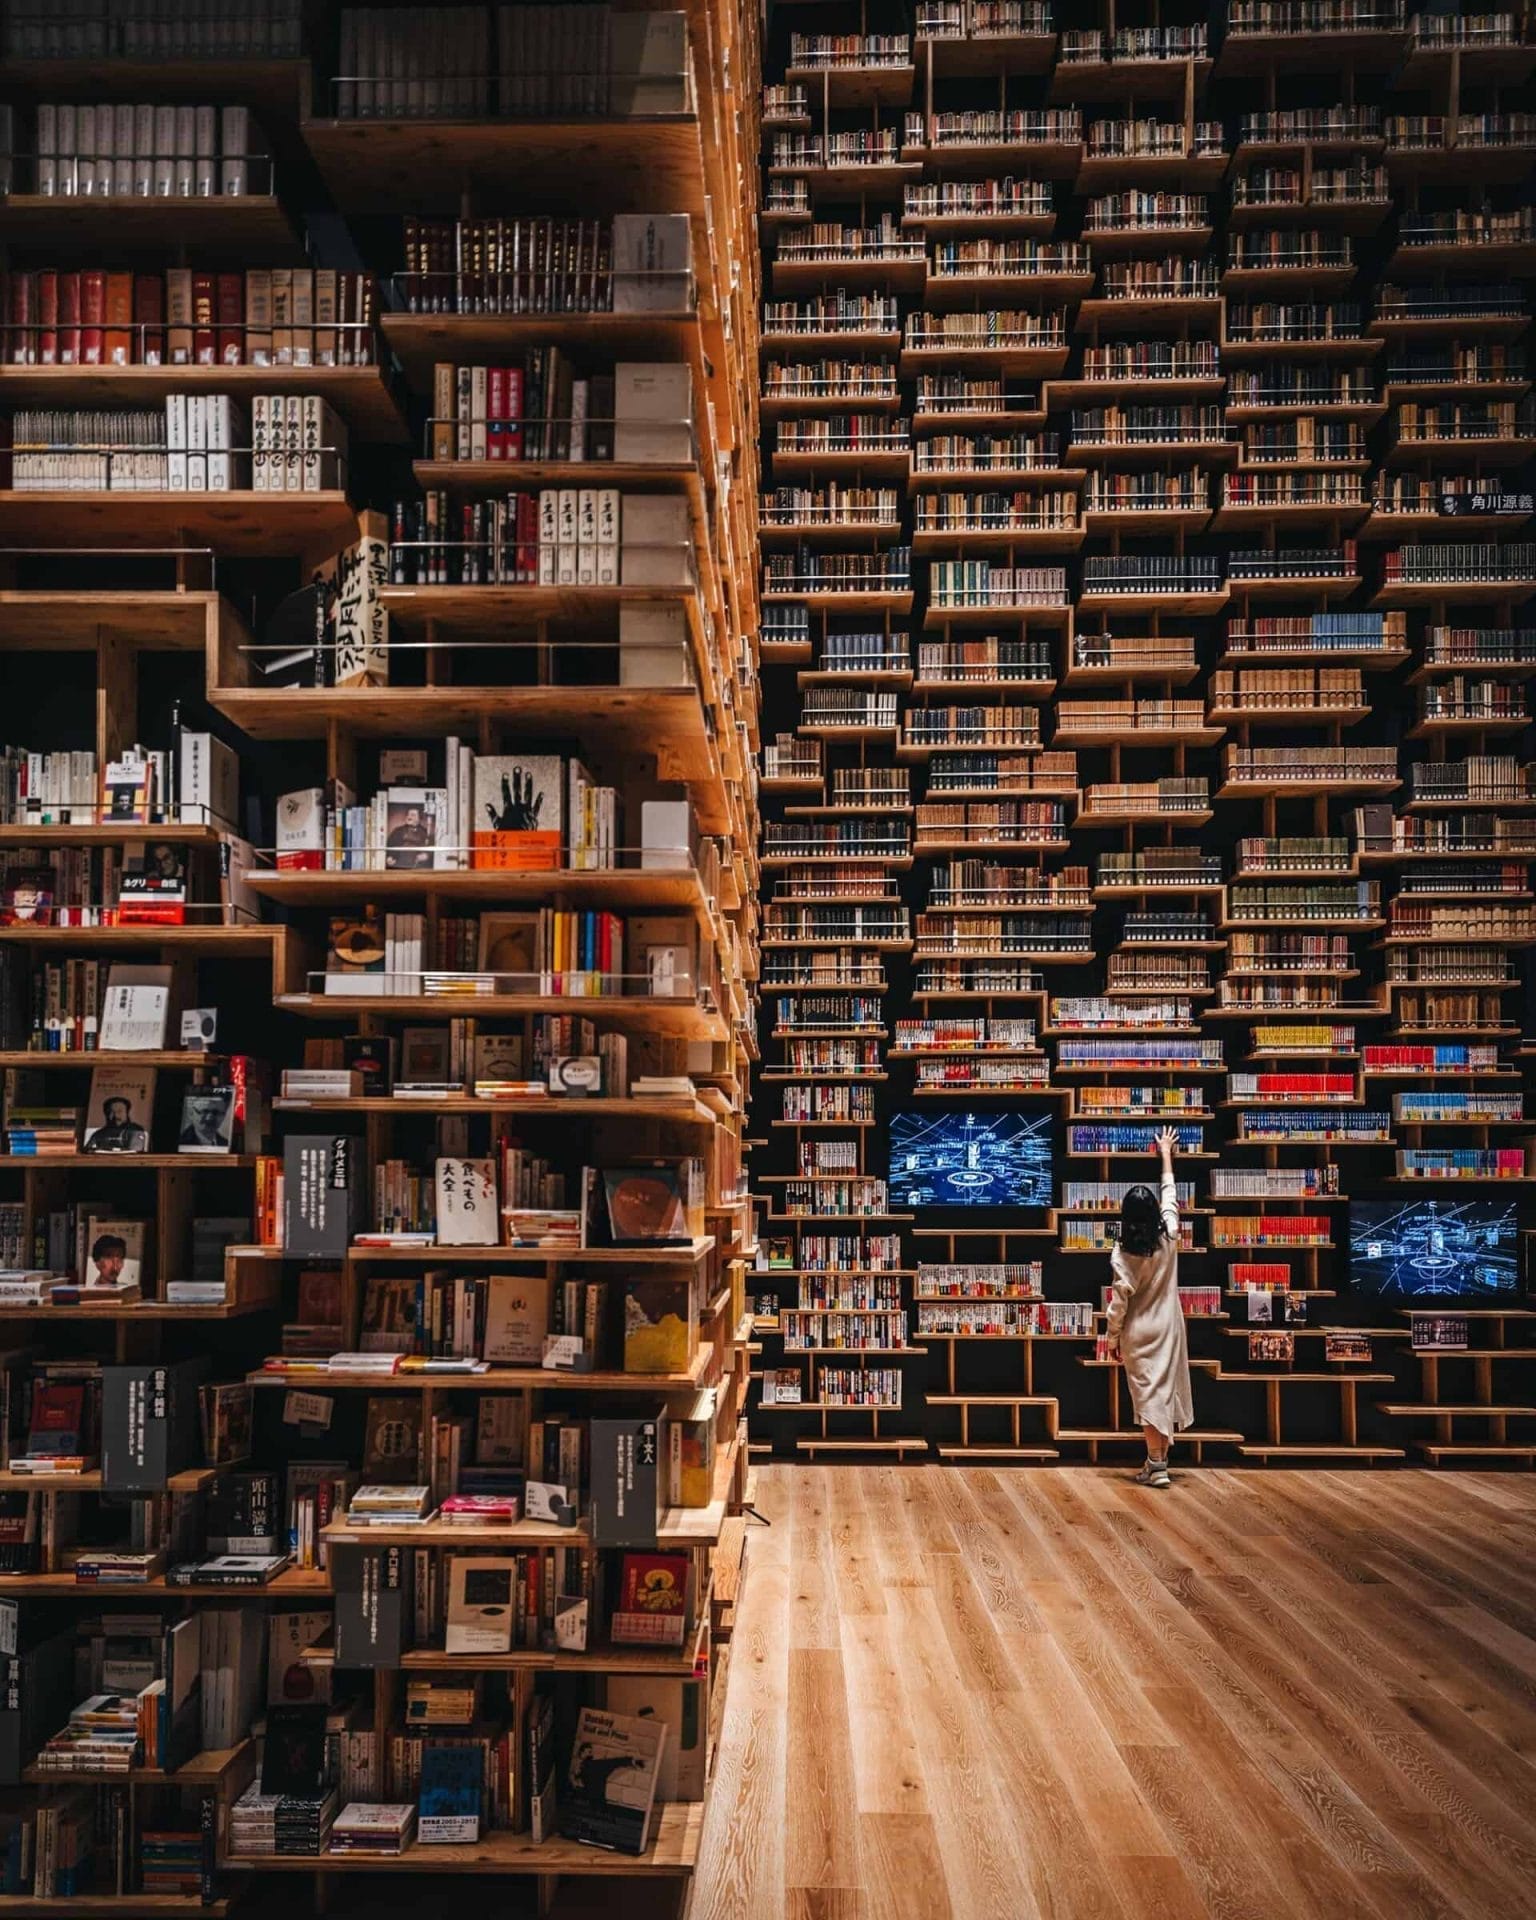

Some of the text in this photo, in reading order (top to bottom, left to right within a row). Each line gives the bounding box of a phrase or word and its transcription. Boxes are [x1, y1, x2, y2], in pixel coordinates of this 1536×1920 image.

[1471, 494, 1534, 510] 角川源義
[442, 1162, 456, 1193] 大全
[462, 1162, 476, 1212] 食べもの
